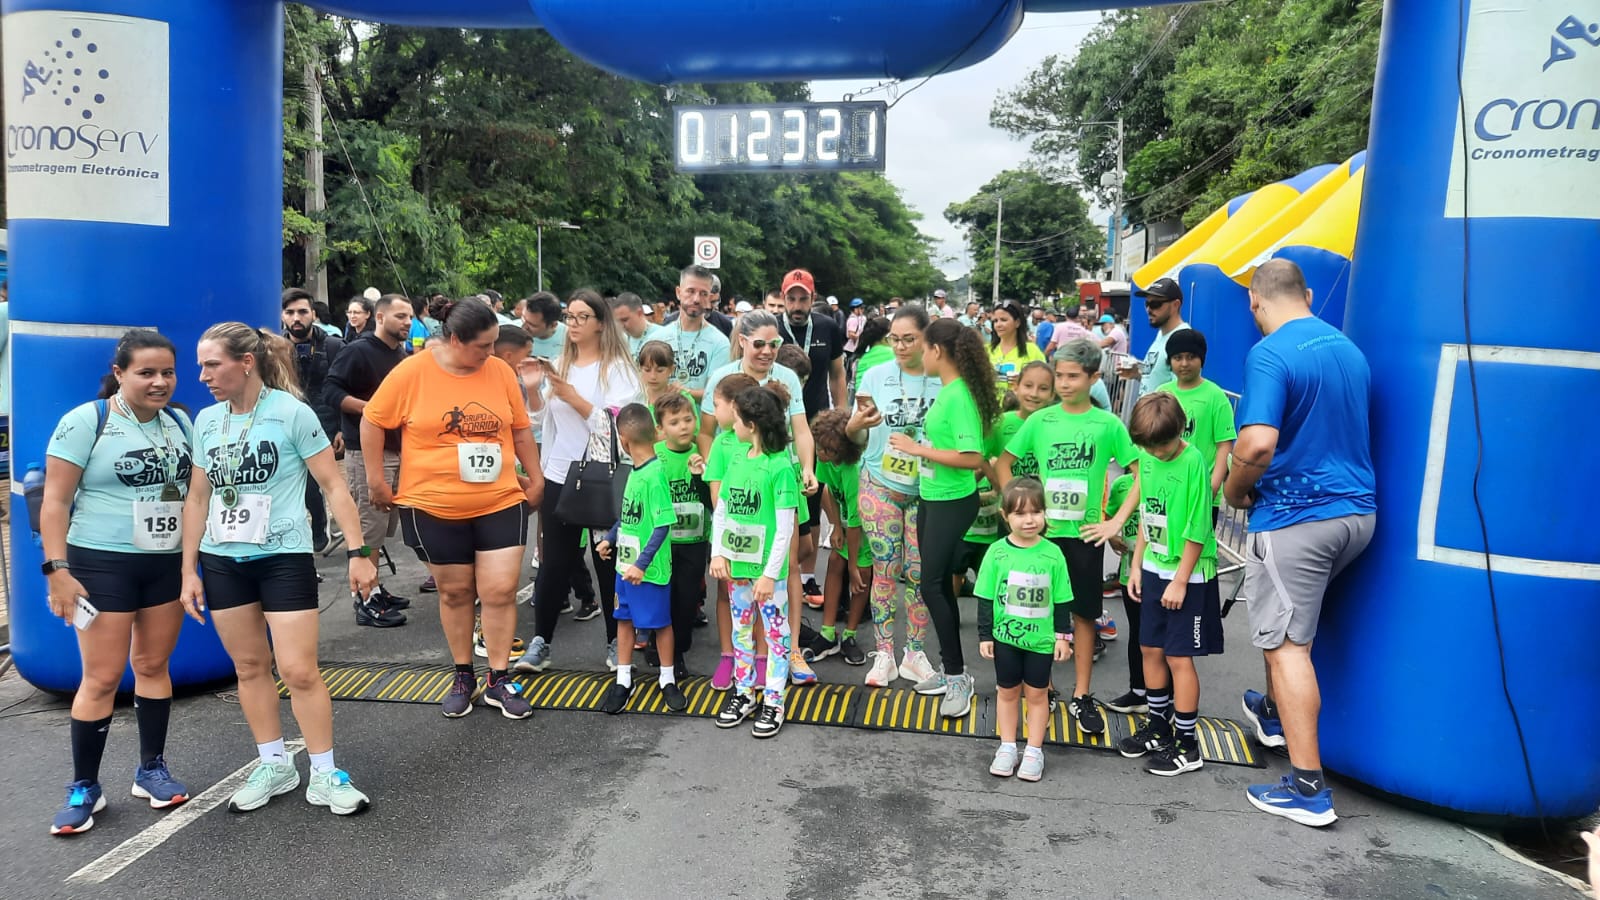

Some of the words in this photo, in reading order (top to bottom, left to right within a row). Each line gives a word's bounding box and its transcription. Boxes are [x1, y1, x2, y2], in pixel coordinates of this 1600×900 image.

[81, 163, 160, 179] Eletrônica
[703, 244, 712, 257] E
[462, 421, 499, 432] CORRIDA
[468, 455, 495, 468] 179
[890, 457, 915, 473] 721
[1052, 491, 1080, 506] 630
[220, 509, 251, 524] 159
[143, 517, 178, 532] 158
[728, 532, 753, 549] 602
[1016, 586, 1045, 603] 618
[1193, 615, 1202, 649] LACOSTE
